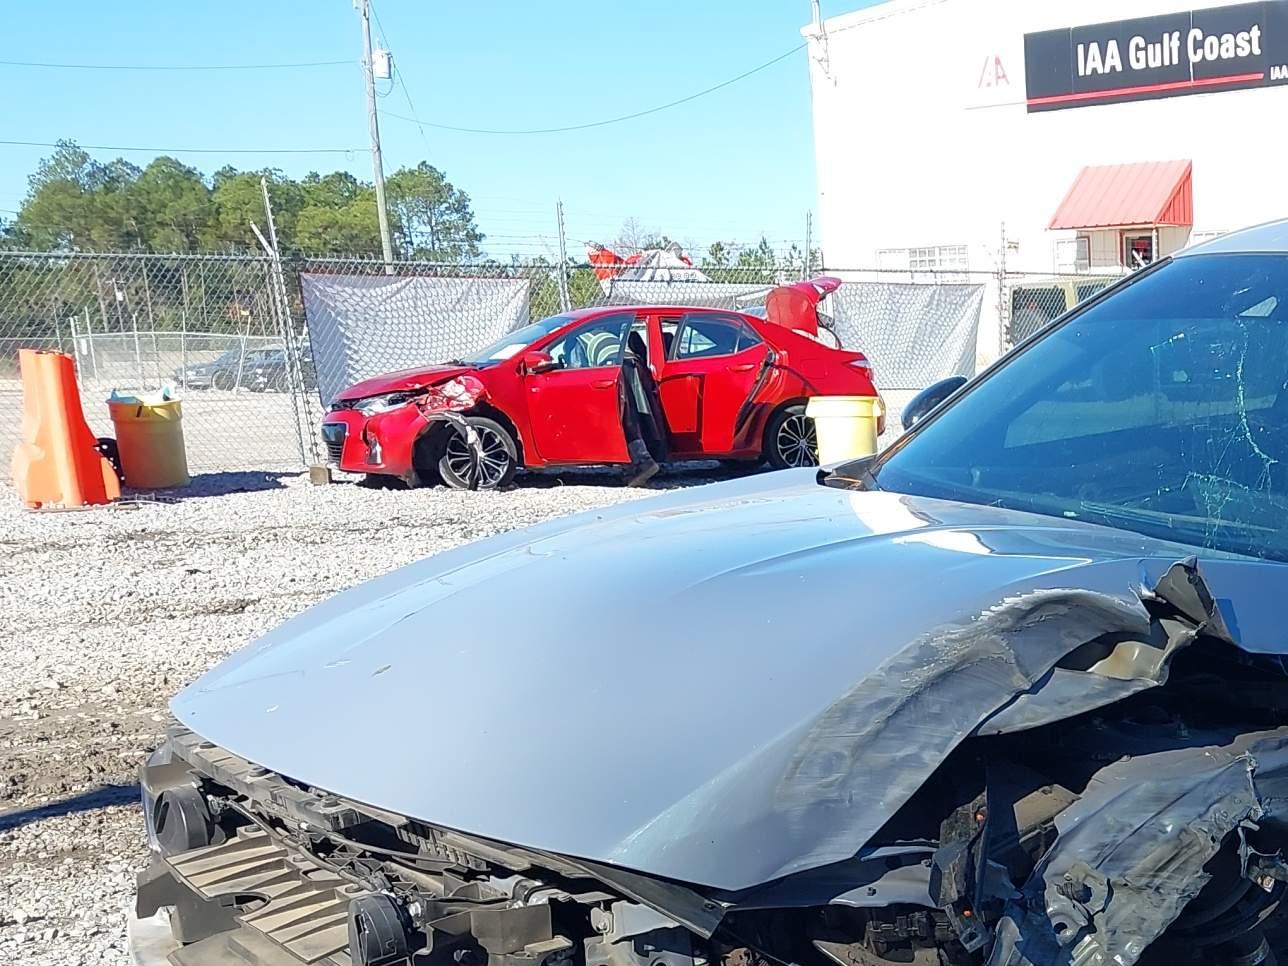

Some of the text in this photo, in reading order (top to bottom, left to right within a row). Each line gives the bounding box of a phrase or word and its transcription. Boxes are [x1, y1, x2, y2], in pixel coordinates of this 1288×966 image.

[1077, 24, 1261, 77] IAA Gulf Coast
